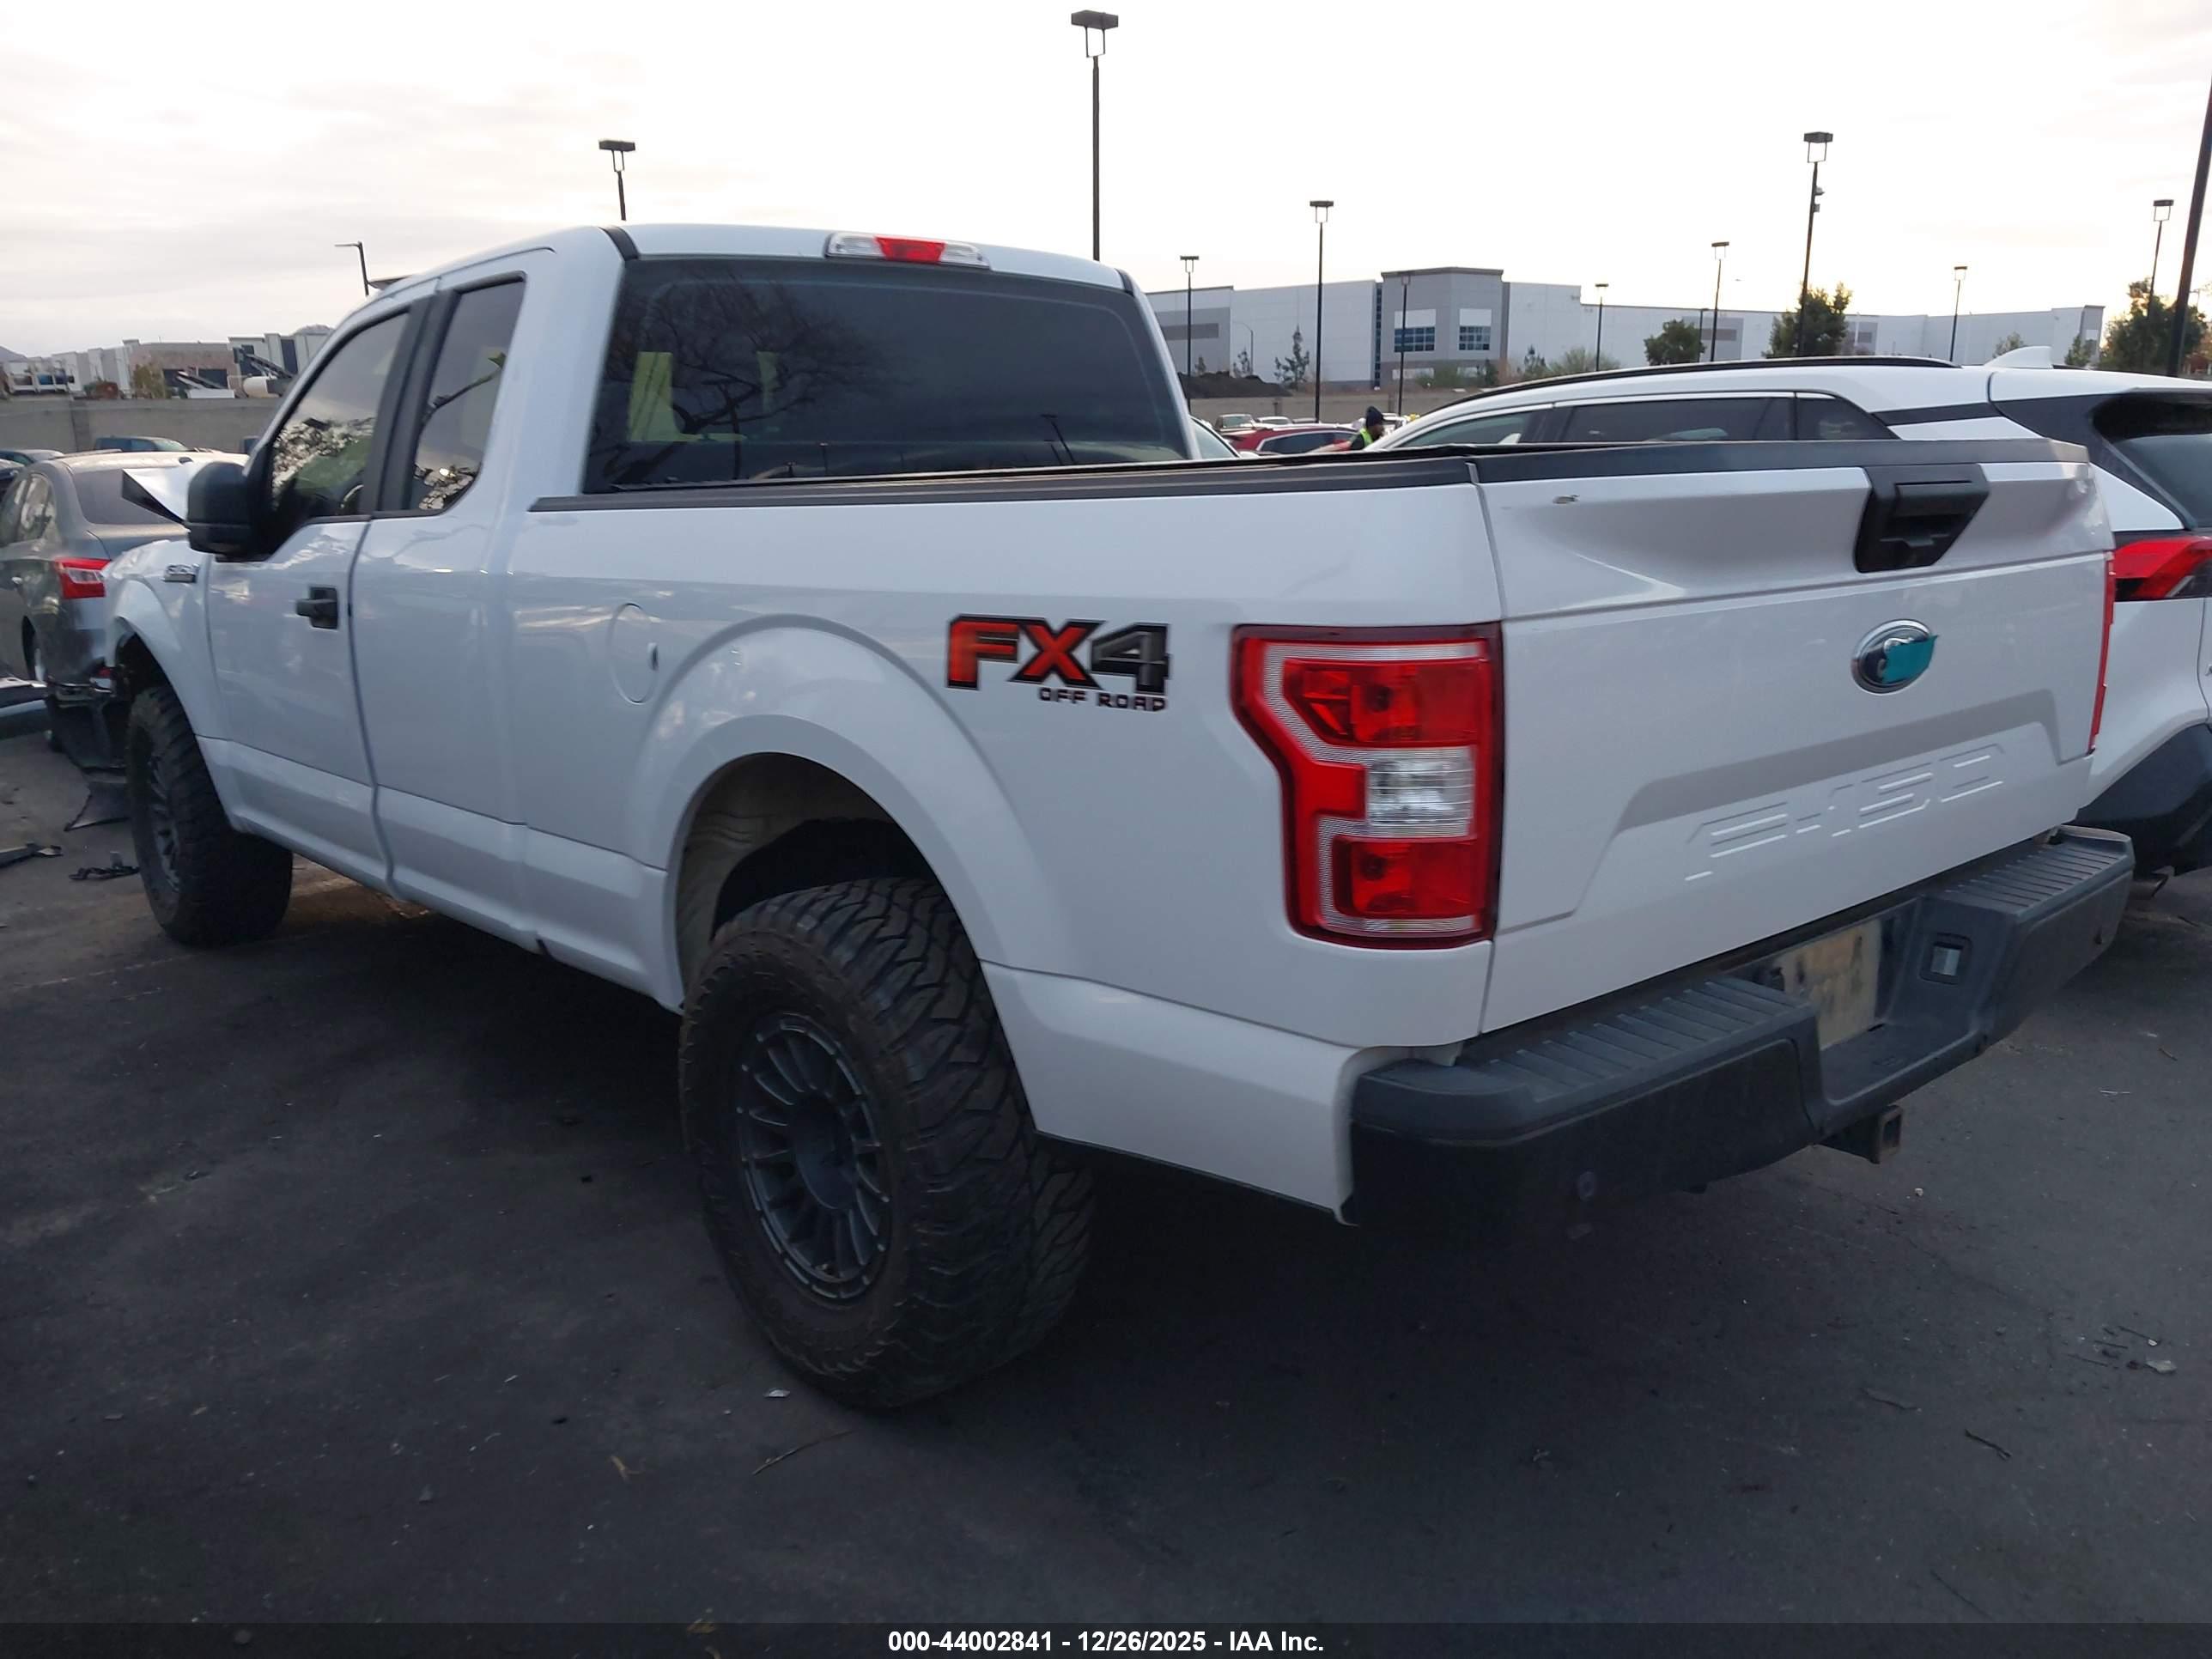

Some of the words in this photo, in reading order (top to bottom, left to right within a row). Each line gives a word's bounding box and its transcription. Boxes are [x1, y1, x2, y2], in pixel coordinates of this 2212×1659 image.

[947, 613, 1171, 697] FX4
[1039, 687, 1087, 703] OFF
[1097, 692, 1166, 712] ROAD
[1685, 742, 2006, 883] F-150
